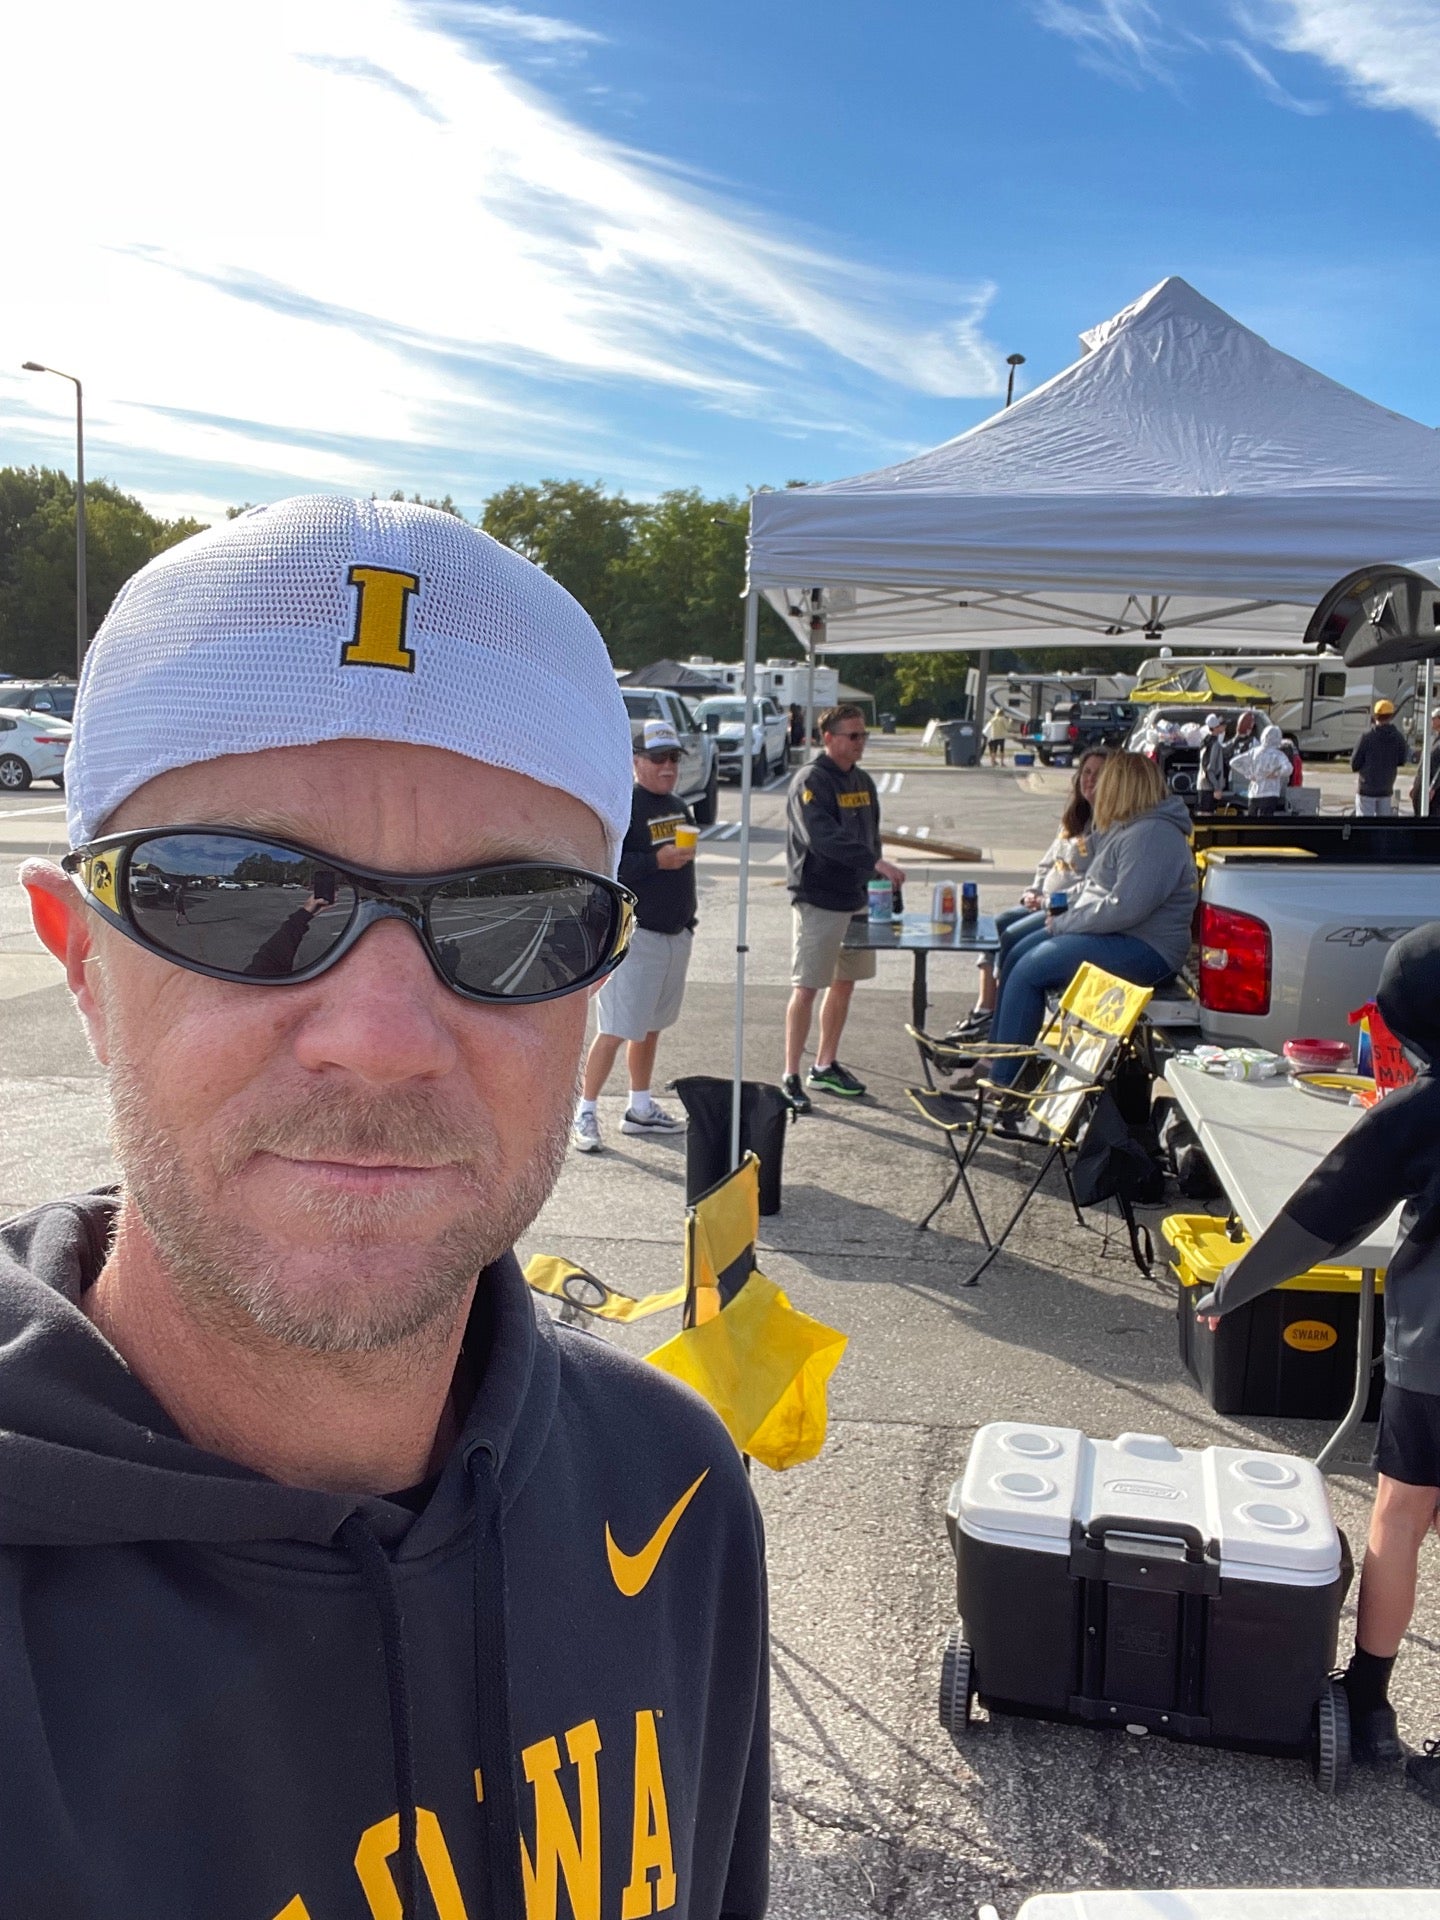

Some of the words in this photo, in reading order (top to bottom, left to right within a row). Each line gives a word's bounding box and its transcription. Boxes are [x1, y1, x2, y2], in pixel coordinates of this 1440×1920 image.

[340, 565, 420, 674] I
[1292, 1328, 1329, 1341] SWARM
[271, 1708, 678, 1920] OWA
